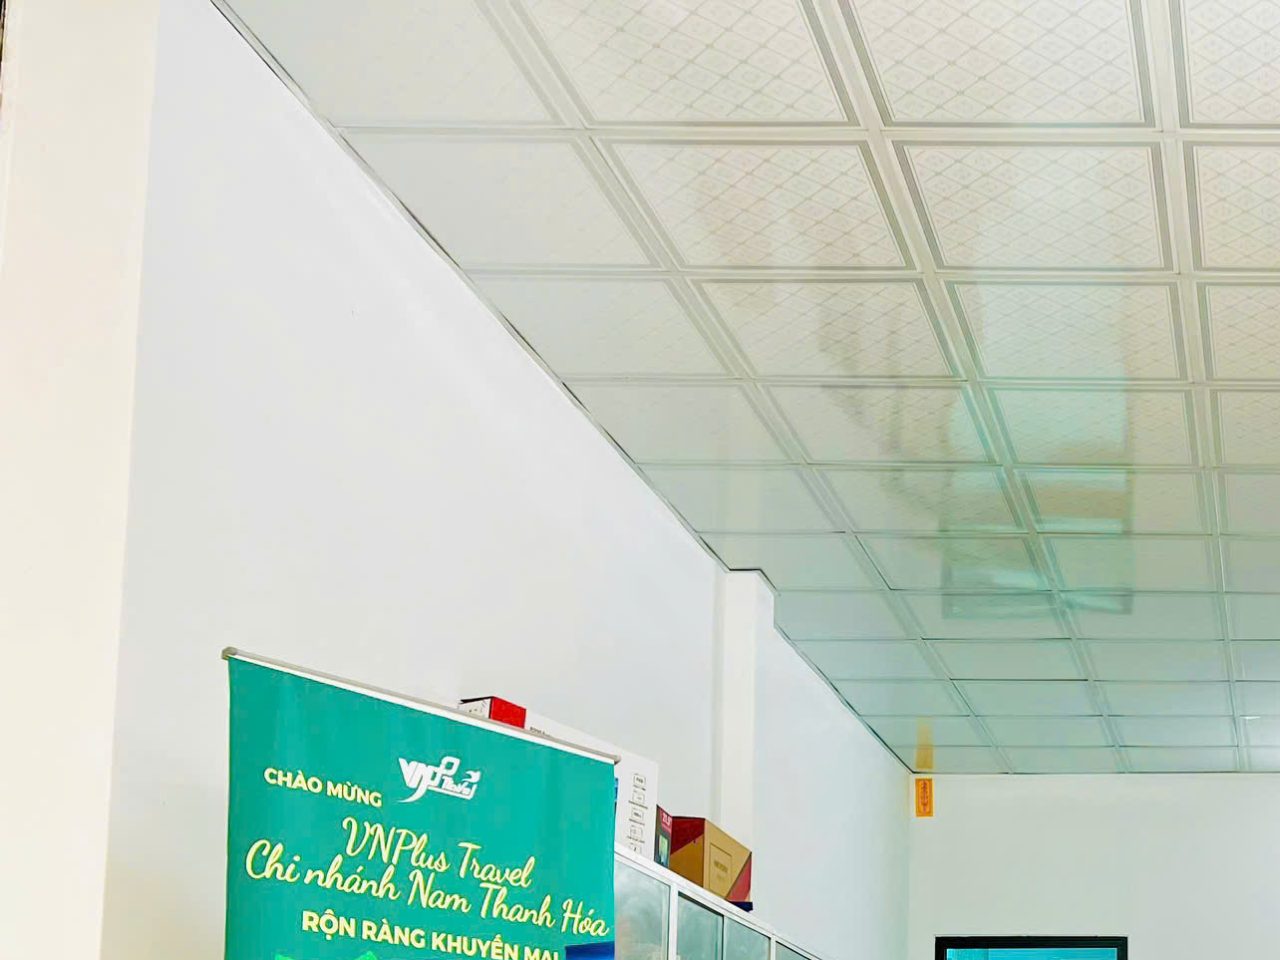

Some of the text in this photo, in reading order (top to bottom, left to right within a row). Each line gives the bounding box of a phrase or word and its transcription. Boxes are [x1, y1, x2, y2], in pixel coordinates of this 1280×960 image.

[264, 767, 383, 808] CHÀO MỪNG
[342, 816, 536, 888] VNPlus Travel
[245, 839, 610, 937] Chi nhánh Nam Thanh Hóa
[302, 908, 356, 940] RỘN
[362, 918, 426, 948] RÀNG
